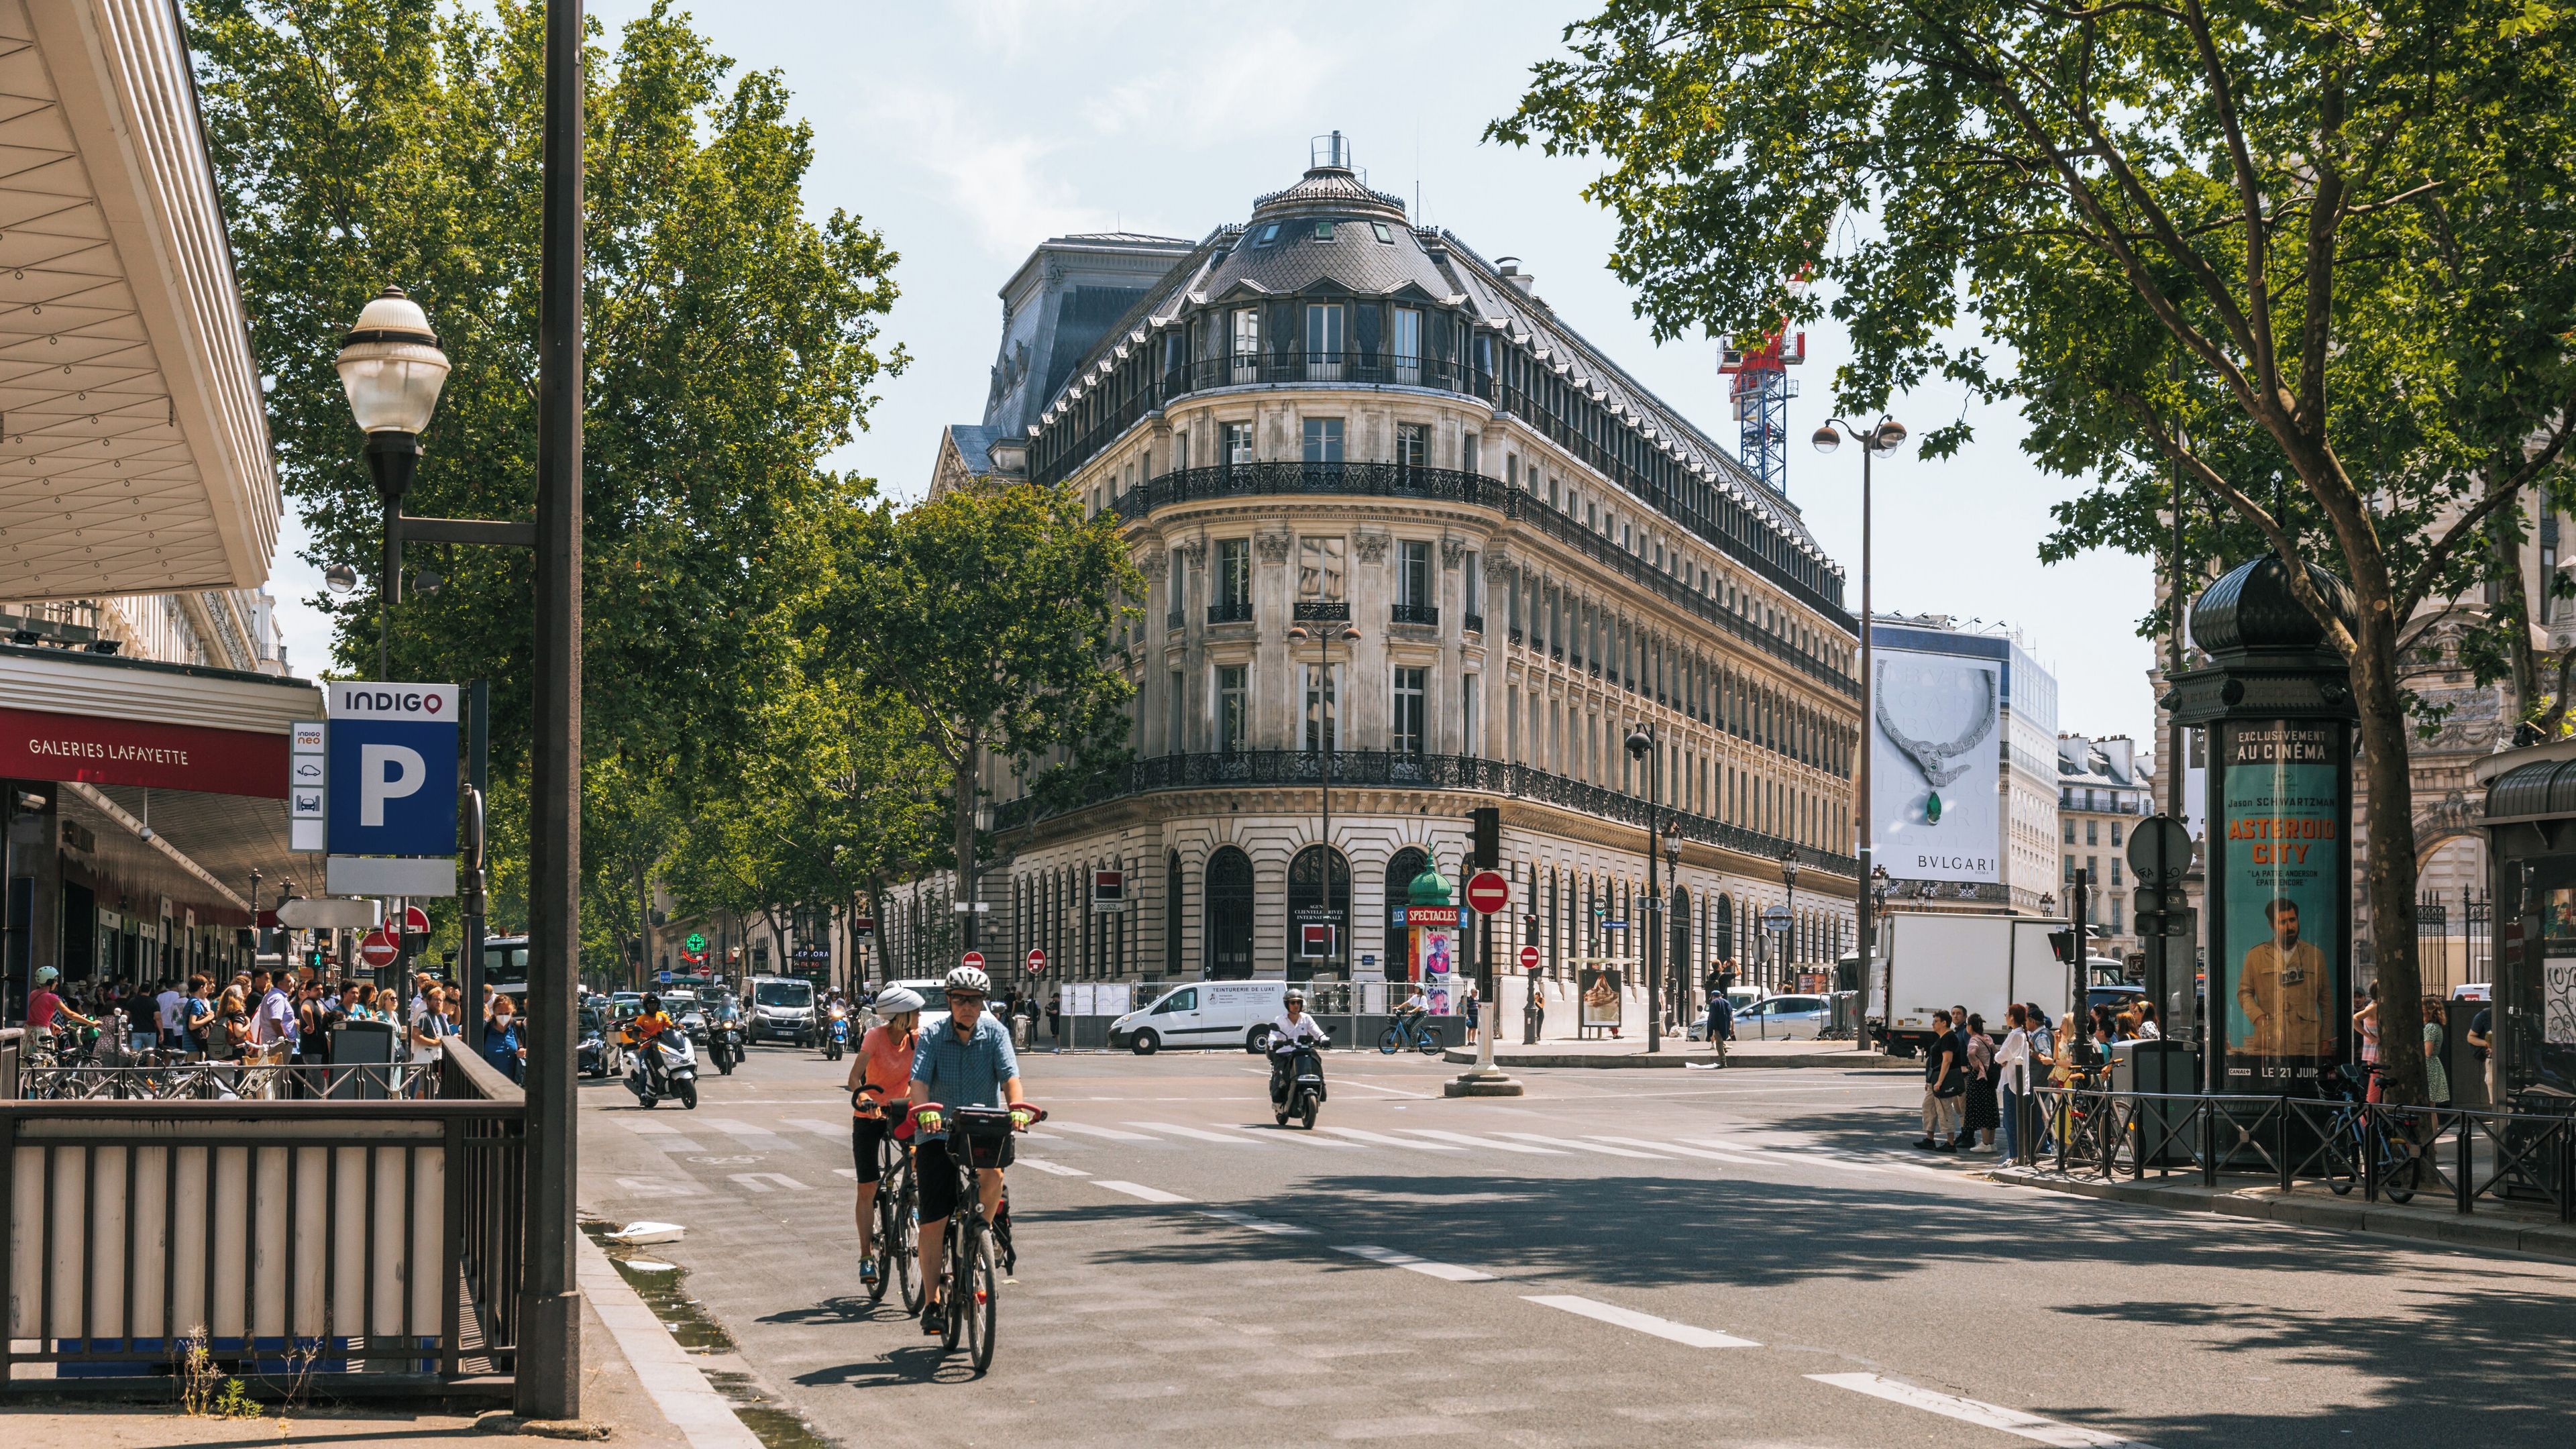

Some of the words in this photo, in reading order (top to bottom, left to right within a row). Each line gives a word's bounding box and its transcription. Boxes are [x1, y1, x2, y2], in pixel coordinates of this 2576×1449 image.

[346, 692, 443, 714] INDIGO
[2239, 731, 2326, 742] EXCLUSIVEMENT
[30, 739, 104, 758] GALERIES
[109, 745, 189, 765] LAFAYETTE
[2238, 745, 2257, 760] AU
[2264, 741, 2326, 759] CINÉMA
[361, 744, 426, 826] P
[2229, 799, 2253, 808] Jason
[2257, 797, 2335, 807] SCHWARTZMAN
[2229, 817, 2336, 840] ASTEROID
[1918, 855, 1994, 871] BVLGARI
[2253, 843, 2310, 864] CITY
[1409, 910, 1456, 921] SPECTACLES
[2262, 1067, 2274, 1077] LE
[2280, 1067, 2291, 1077] 21
